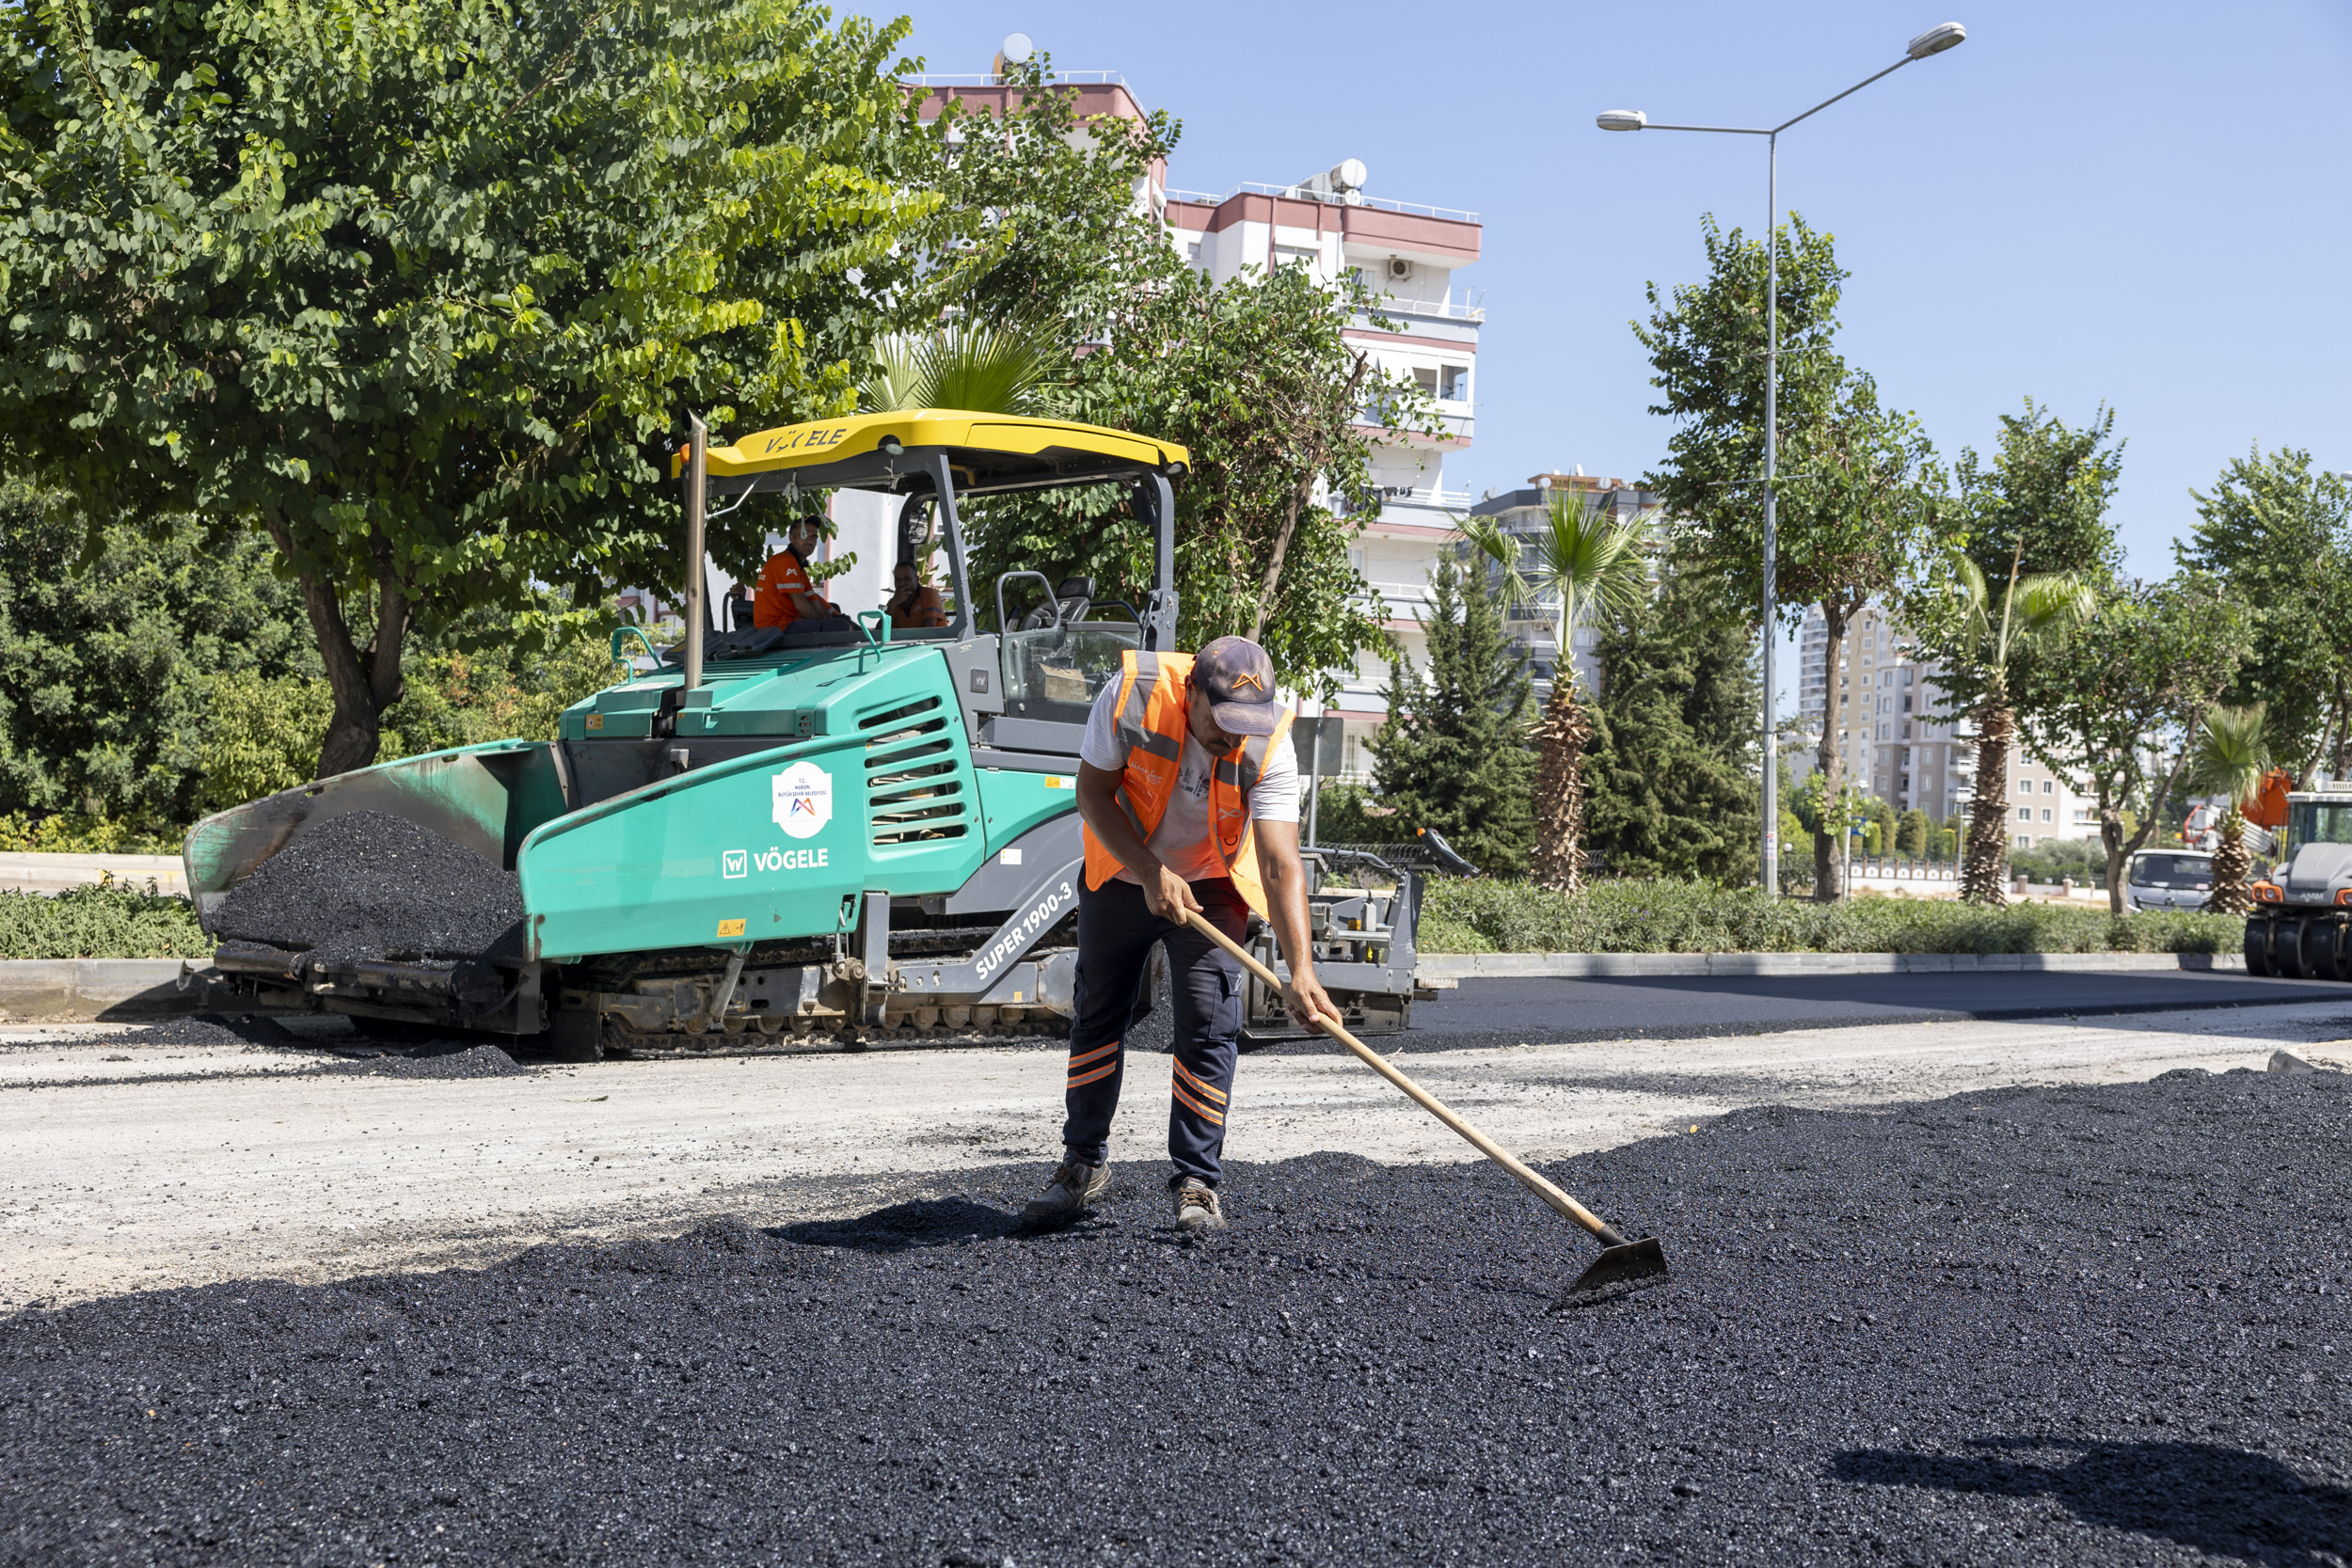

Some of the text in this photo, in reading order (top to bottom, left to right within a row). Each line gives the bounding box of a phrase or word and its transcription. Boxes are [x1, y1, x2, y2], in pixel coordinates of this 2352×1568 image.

[765, 428, 847, 453] VELE
[754, 846, 829, 872] VÖGELE
[976, 881, 1073, 980] SUPER 1900-3
